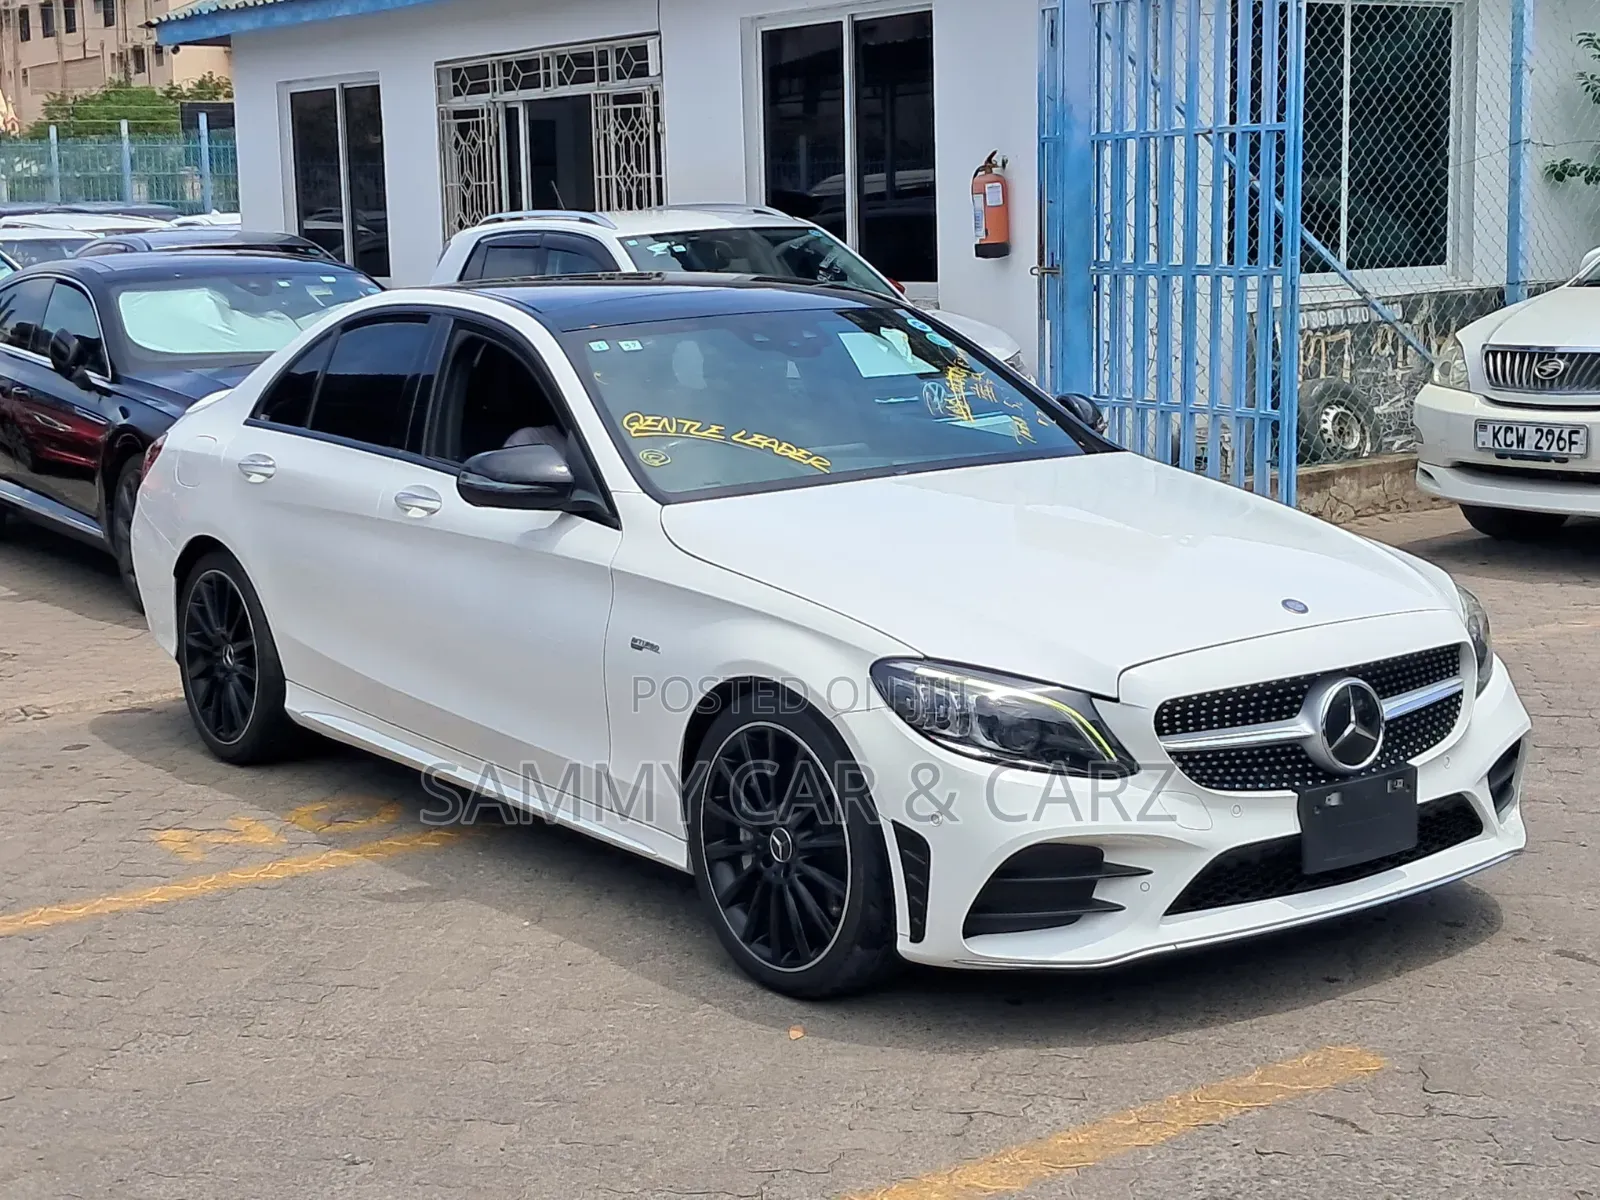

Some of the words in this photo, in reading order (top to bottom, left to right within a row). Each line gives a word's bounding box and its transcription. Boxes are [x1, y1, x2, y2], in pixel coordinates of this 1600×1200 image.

[731, 429, 832, 474] LEADER
[1492, 425, 1527, 449] KCW
[1534, 427, 1580, 453] 296F
